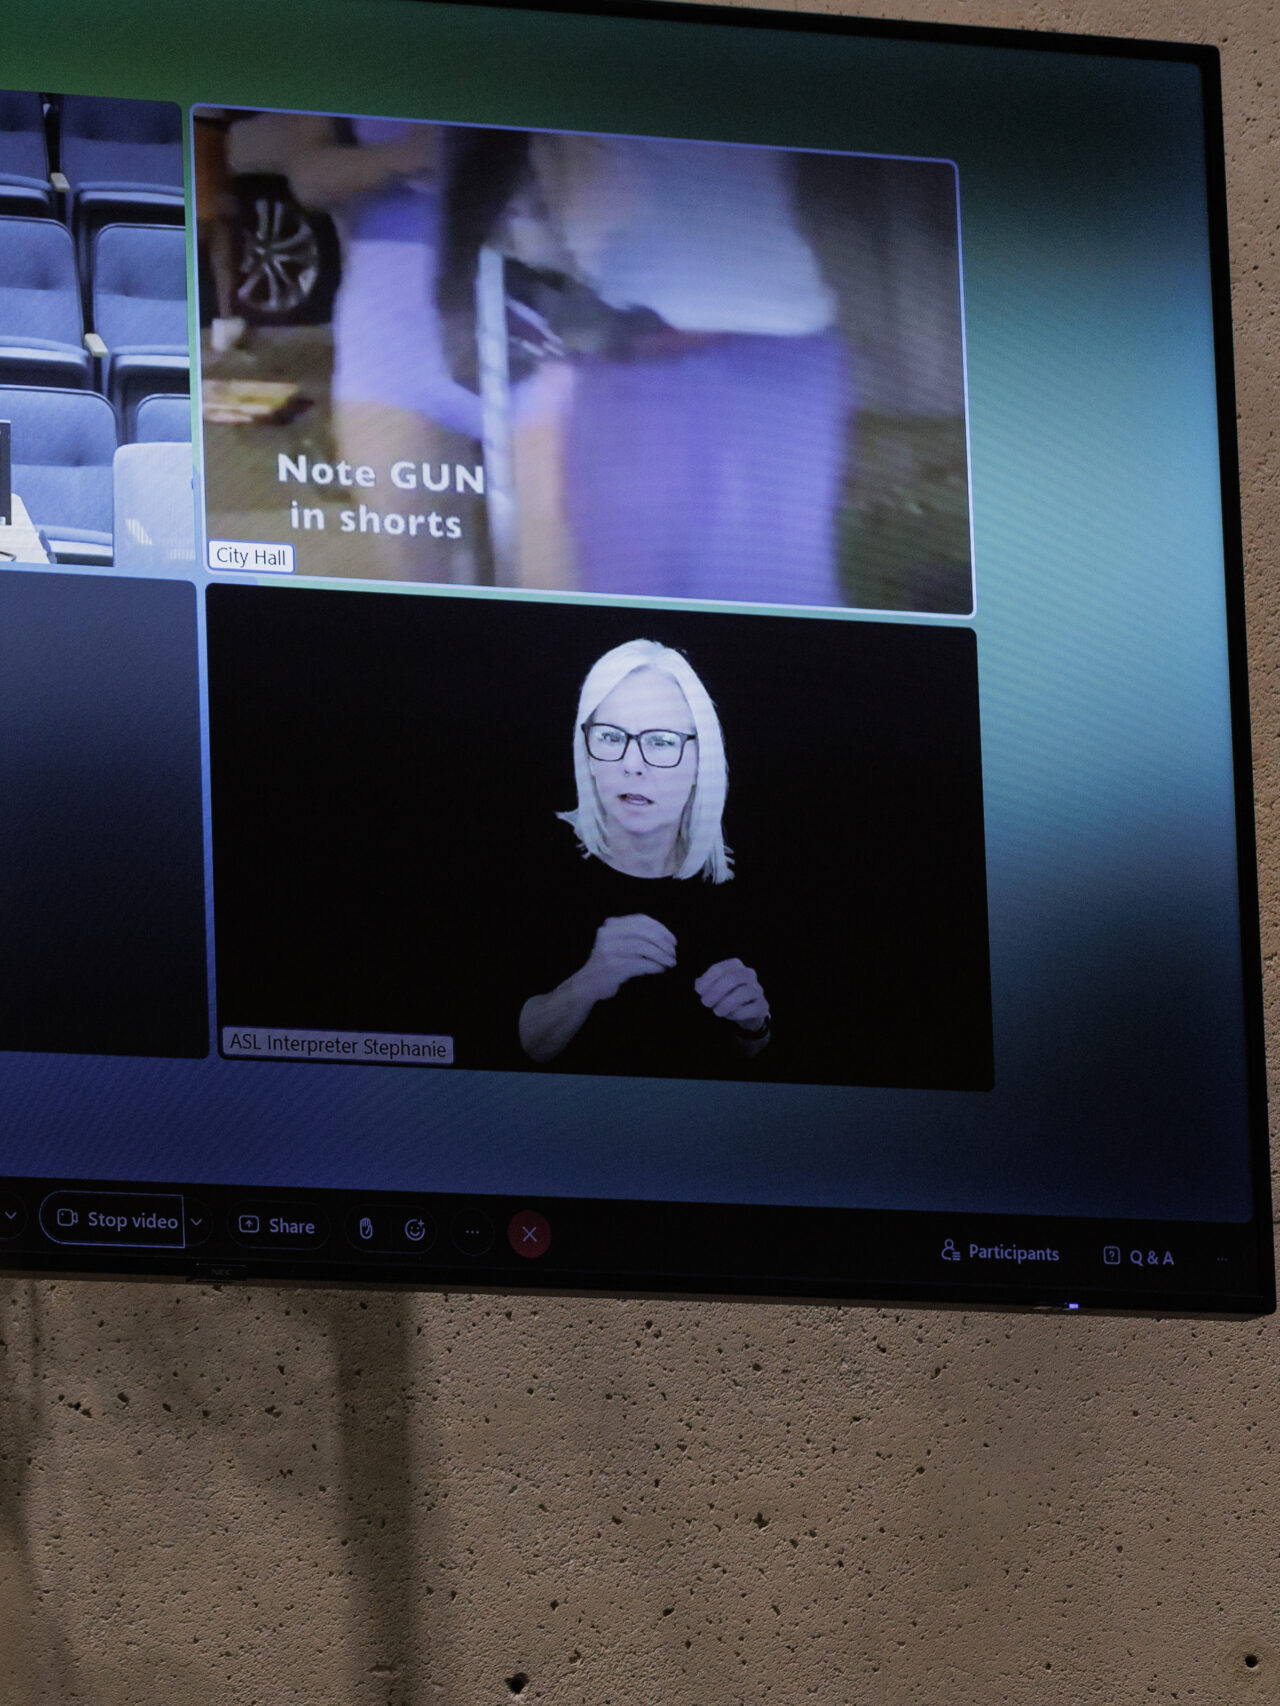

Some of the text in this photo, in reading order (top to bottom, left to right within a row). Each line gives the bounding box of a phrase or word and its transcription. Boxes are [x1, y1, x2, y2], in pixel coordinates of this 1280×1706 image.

[278, 453, 484, 494] Note GUN
[290, 500, 462, 538] in shorts
[217, 546, 286, 568] City Hall
[230, 1033, 447, 1059] ASL Interpreter Stephanie
[88, 1211, 178, 1231] Stop video
[269, 1217, 315, 1234] Share
[969, 1243, 1060, 1264] Participants
[1130, 1250, 1175, 1266] Q & A
